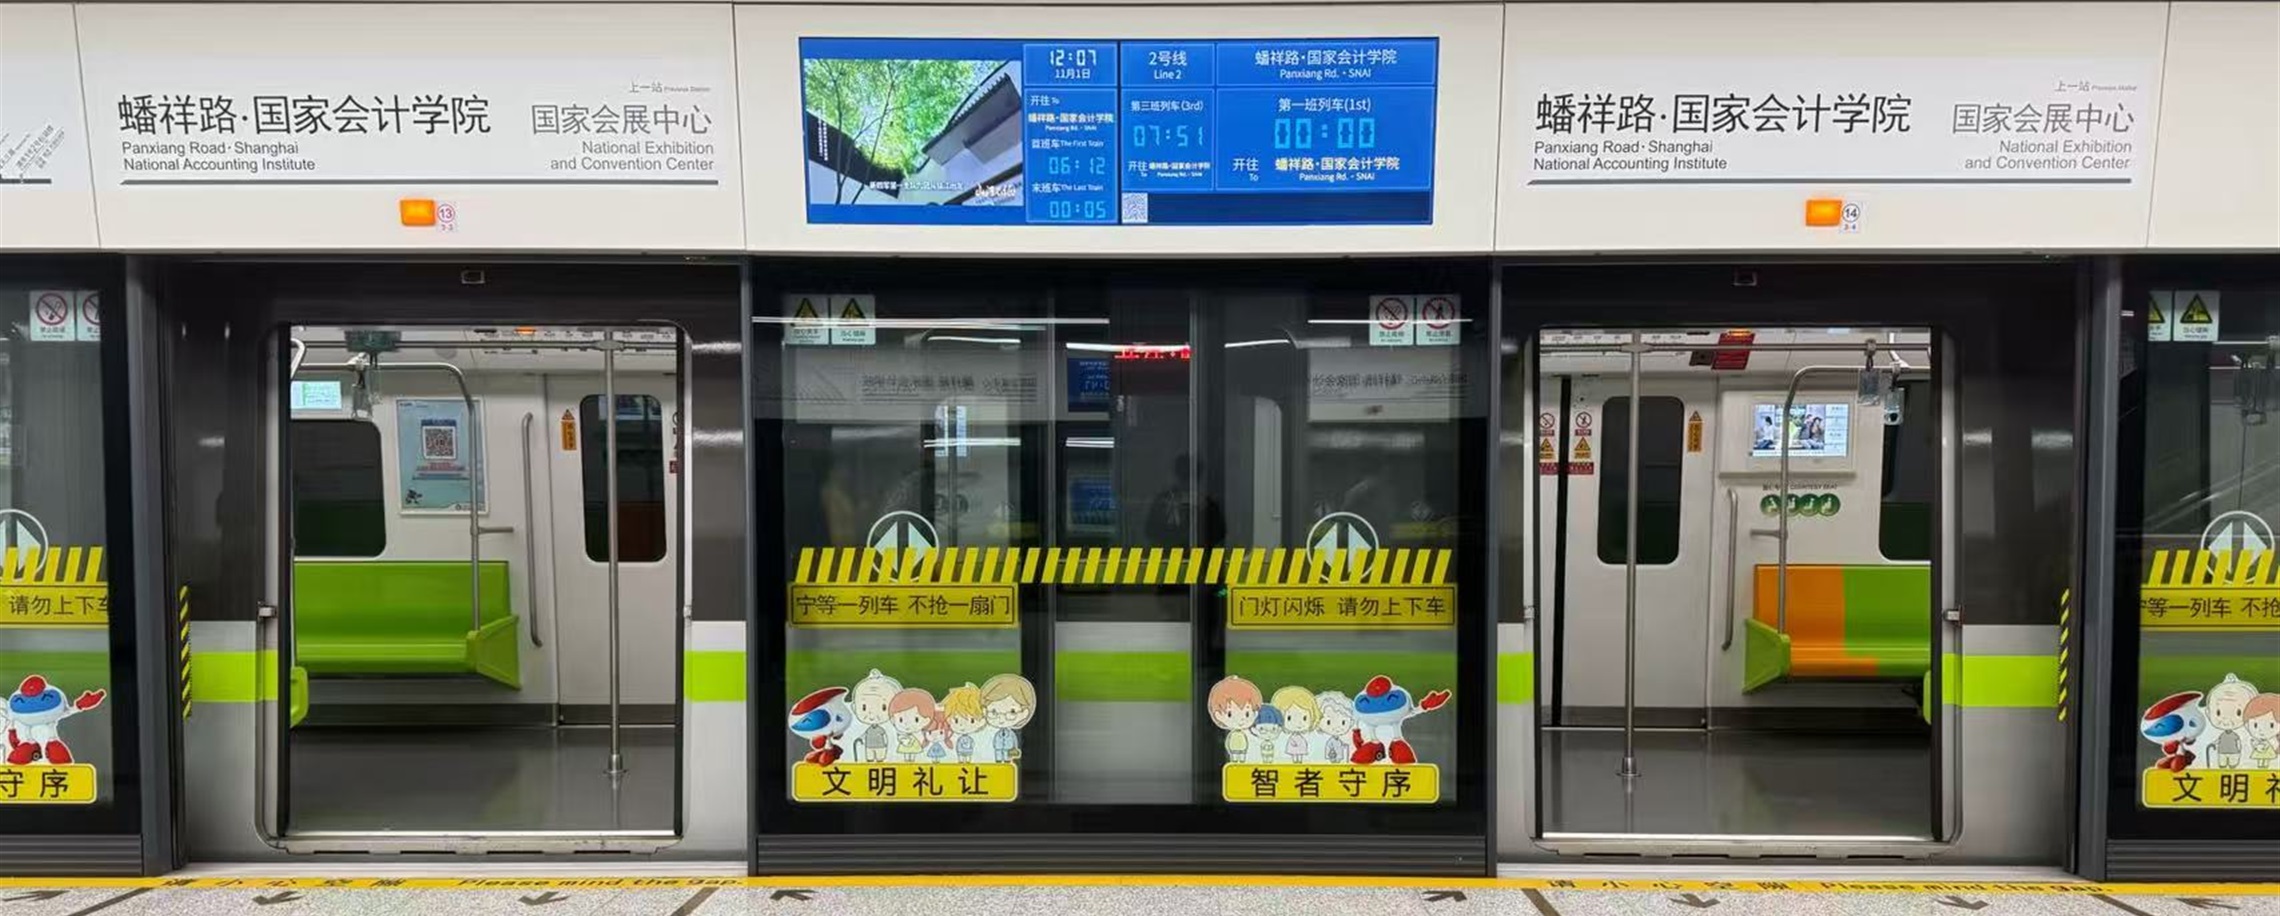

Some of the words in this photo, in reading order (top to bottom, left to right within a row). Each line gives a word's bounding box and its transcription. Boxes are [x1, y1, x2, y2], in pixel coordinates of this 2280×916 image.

[1050, 49, 1096, 66] 12:07
[1149, 50, 1187, 66] 2号线
[1255, 49, 1397, 67] 蟠祥路·国家会计学院
[1055, 68, 1090, 79] 11月1日
[1154, 70, 1174, 79] Line
[1176, 69, 1181, 79] 2
[1280, 69, 1322, 81] Panxiang
[1324, 68, 1339, 78] Rd.
[1348, 68, 1371, 78] SNAI
[629, 81, 663, 93] 上一站
[2054, 80, 2091, 93] 上一站
[1031, 95, 1050, 106] 开往
[1131, 100, 1203, 111] 第三班列车(3rd)
[1279, 98, 1371, 113] 第一班列车(1st)
[118, 94, 491, 135] 蟠祥路·国家会计学院
[532, 104, 711, 134] 国家会展中心
[1536, 93, 1911, 134] 蟠祥路·国家会计学院
[1953, 102, 2134, 134] 国家会展中心
[1134, 125, 1203, 147] 07:51
[1275, 118, 1375, 149] 00:00
[122, 141, 185, 157] Panxiang
[582, 141, 640, 154] National
[645, 141, 714, 154] Exhibition
[1535, 141, 1598, 156] Panxiang
[2000, 140, 2058, 153] National
[2063, 140, 2132, 153] Exhibition
[124, 156, 181, 170] National
[182, 156, 258, 173] Accounting
[263, 156, 315, 170] Institute
[551, 157, 576, 170] and
[581, 157, 661, 170] Convention
[666, 157, 714, 170] Center
[1049, 157, 1105, 174] 06:12
[1128, 161, 1148, 173] 开往
[1233, 158, 1259, 171] 开往
[1275, 157, 1400, 173] 蟠祥路·国家会计学院
[1534, 158, 1590, 170] National
[1593, 157, 1669, 173] Accounting
[1674, 157, 1727, 169] Institute
[1965, 157, 1991, 169] and
[1996, 156, 2077, 169] Convention
[2082, 156, 2130, 169] Center
[1249, 172, 1259, 181] To
[1299, 173, 1335, 183] Panxiang
[440, 208, 452, 219] 13
[1050, 201, 1106, 218] 00:05
[1845, 208, 1857, 218] 14
[797, 594, 898, 616] 宁等一列车
[908, 595, 1010, 615] 不抢一扇门
[1240, 596, 1325, 617] 门灯闪烁
[1337, 595, 1447, 618] 请勿上下车
[822, 766, 989, 797] 文明礼让
[1250, 767, 1411, 798] 智者守序
[457, 878, 550, 886] Please
[557, 878, 623, 886] mind
[632, 878, 679, 886] the
[685, 877, 745, 888] gap.
[1819, 881, 1915, 891] Please
[1922, 882, 1987, 891] mind
[1991, 883, 2042, 892] the
[2046, 884, 2114, 894] gap.
